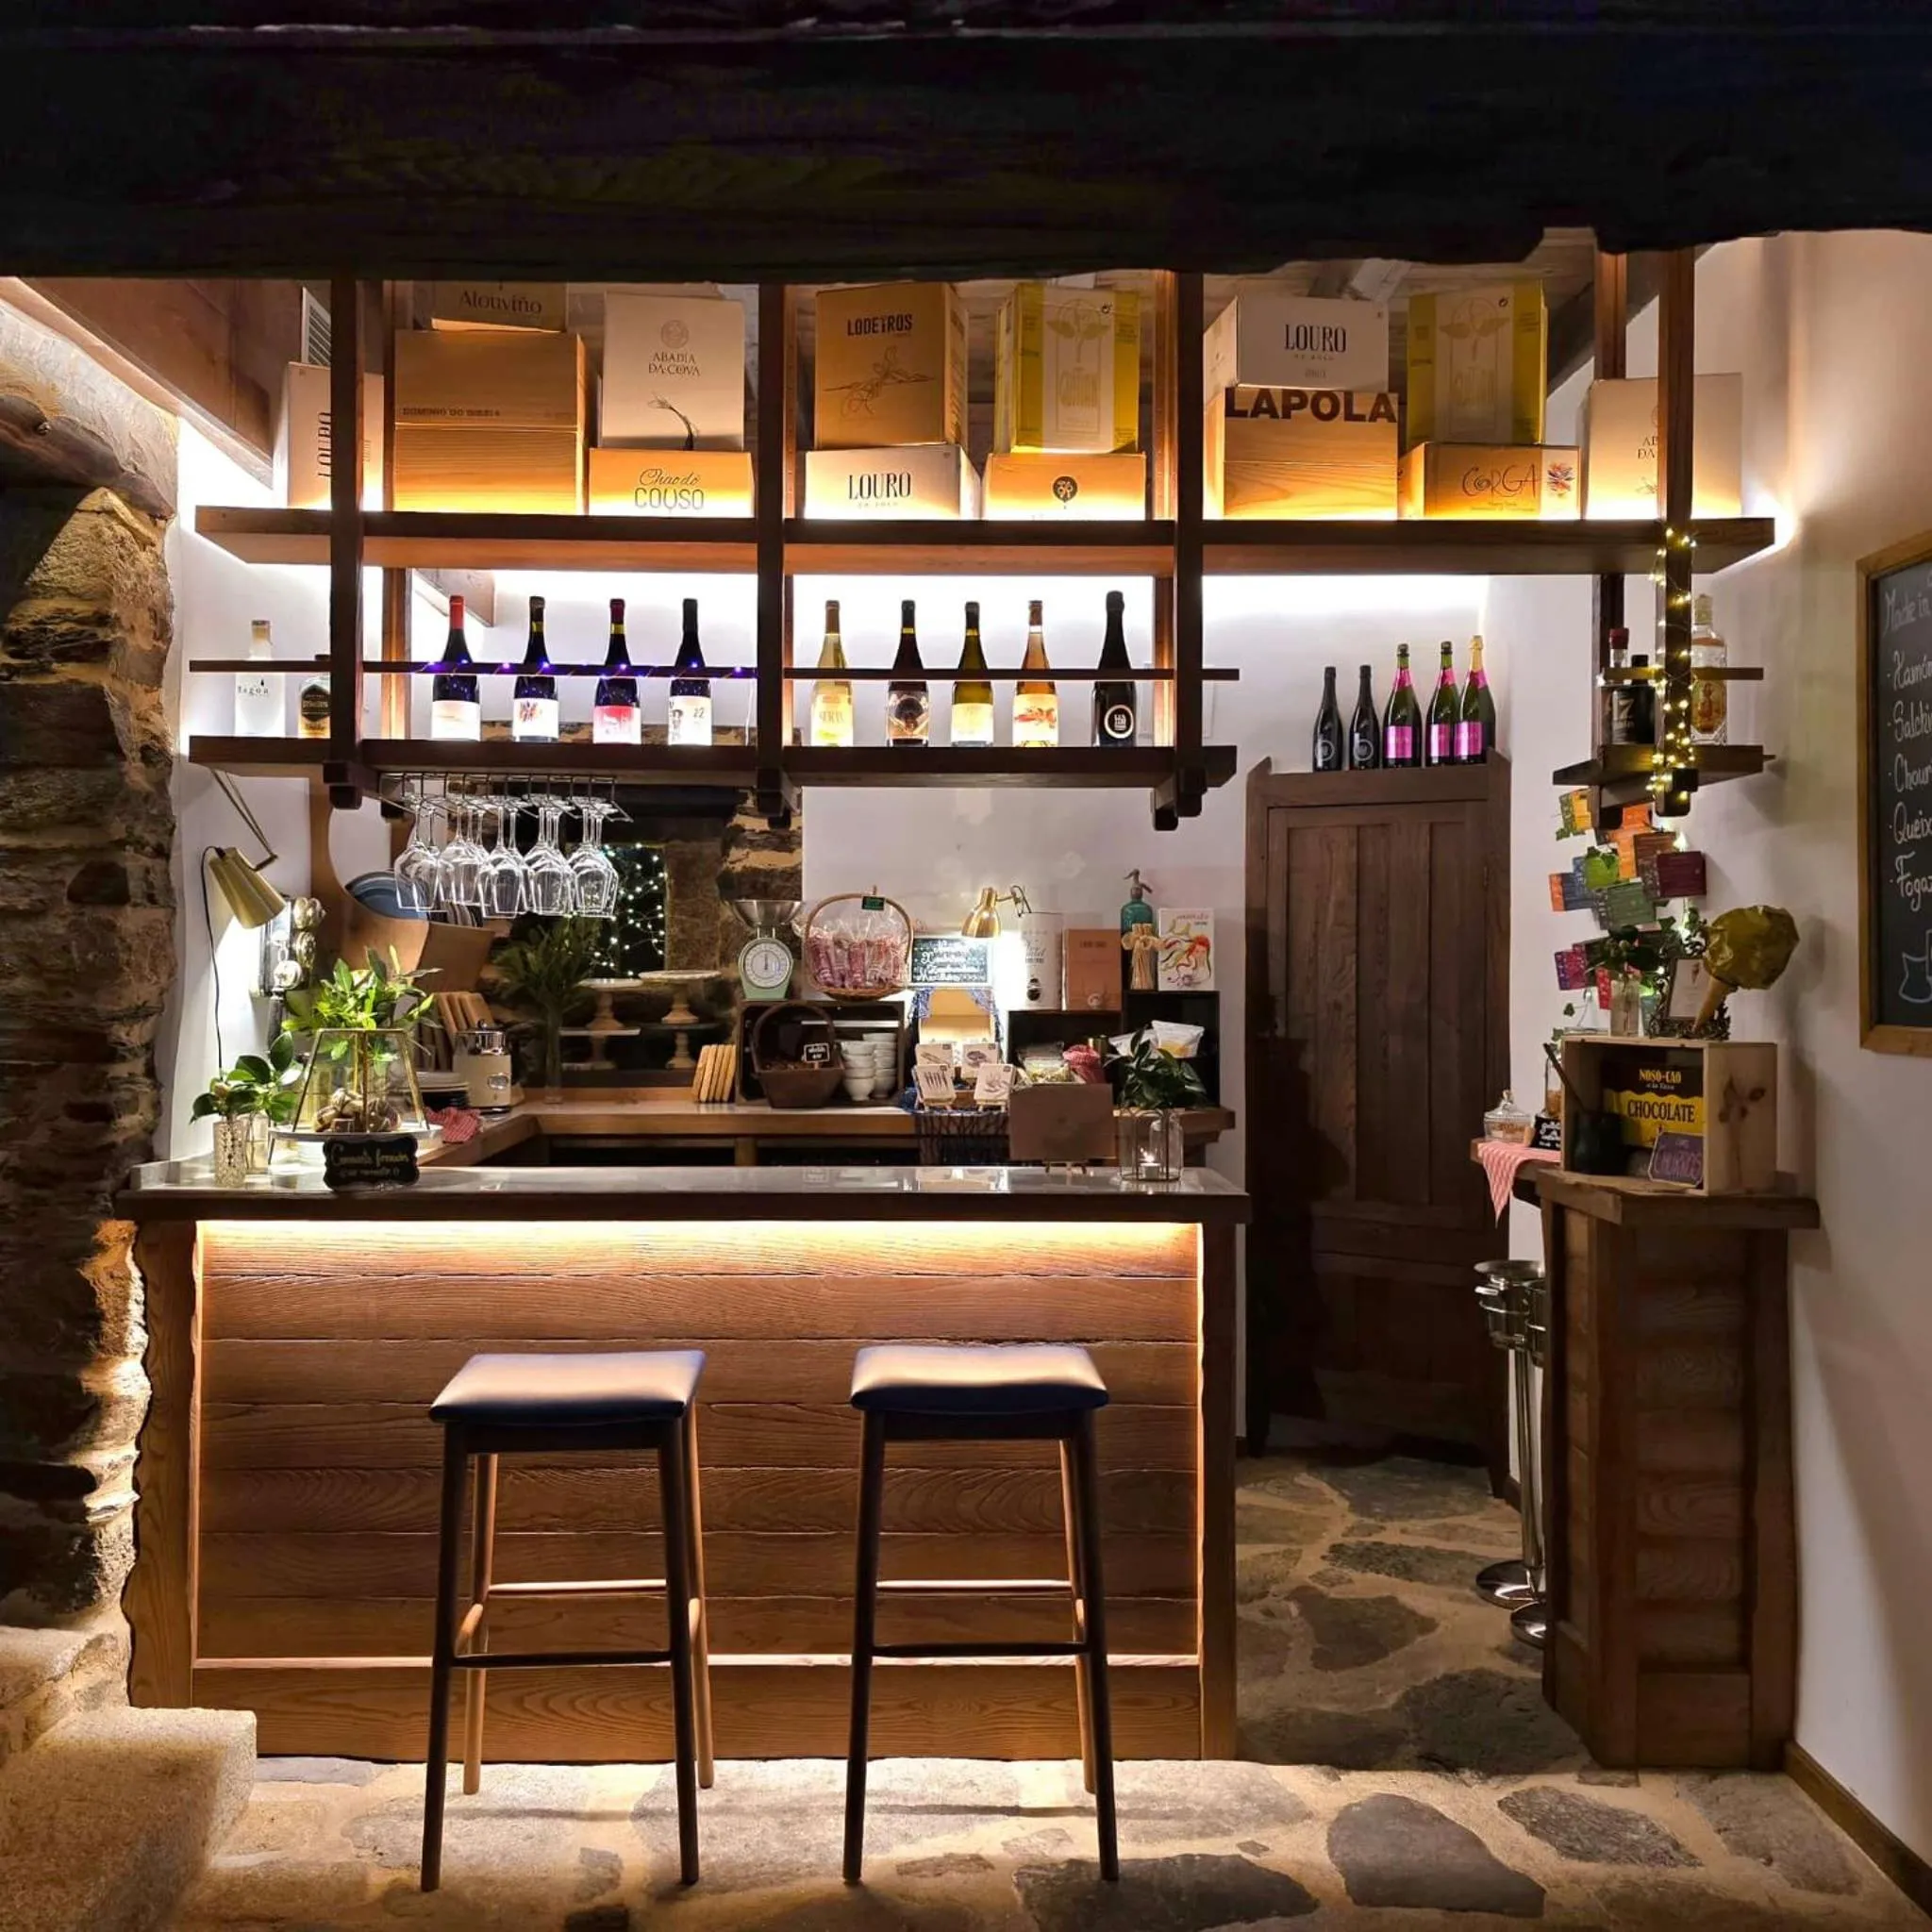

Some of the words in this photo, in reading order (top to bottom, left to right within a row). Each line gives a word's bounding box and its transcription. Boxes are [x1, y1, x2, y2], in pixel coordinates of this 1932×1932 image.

[458, 291, 543, 314] Alouviño
[1285, 324, 1346, 352] LOURO
[667, 364, 701, 376] COVA
[1225, 388, 1397, 424] LAPOLA
[640, 468, 678, 487] Chao
[848, 472, 912, 500] LOURO
[634, 487, 705, 512] COUSO
[1627, 1100, 1696, 1124] CHOCOLATE
